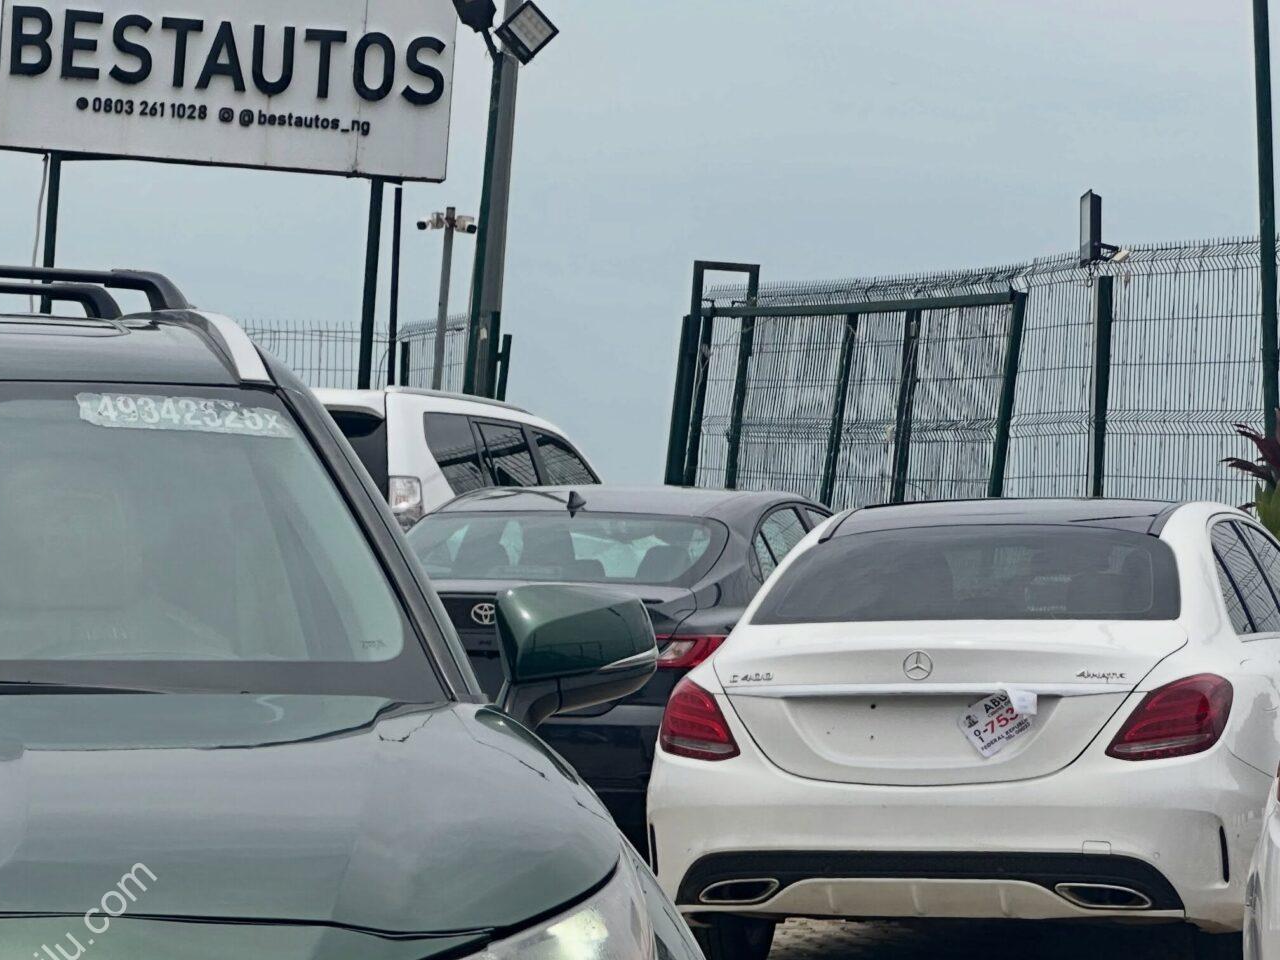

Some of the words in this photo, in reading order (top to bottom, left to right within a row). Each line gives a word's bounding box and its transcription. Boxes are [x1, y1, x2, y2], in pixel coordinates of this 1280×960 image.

[9, 5, 446, 107] BESTAUTOS
[92, 97, 134, 115] 0803
[139, 101, 165, 117] 261
[171, 103, 208, 120] 1028
